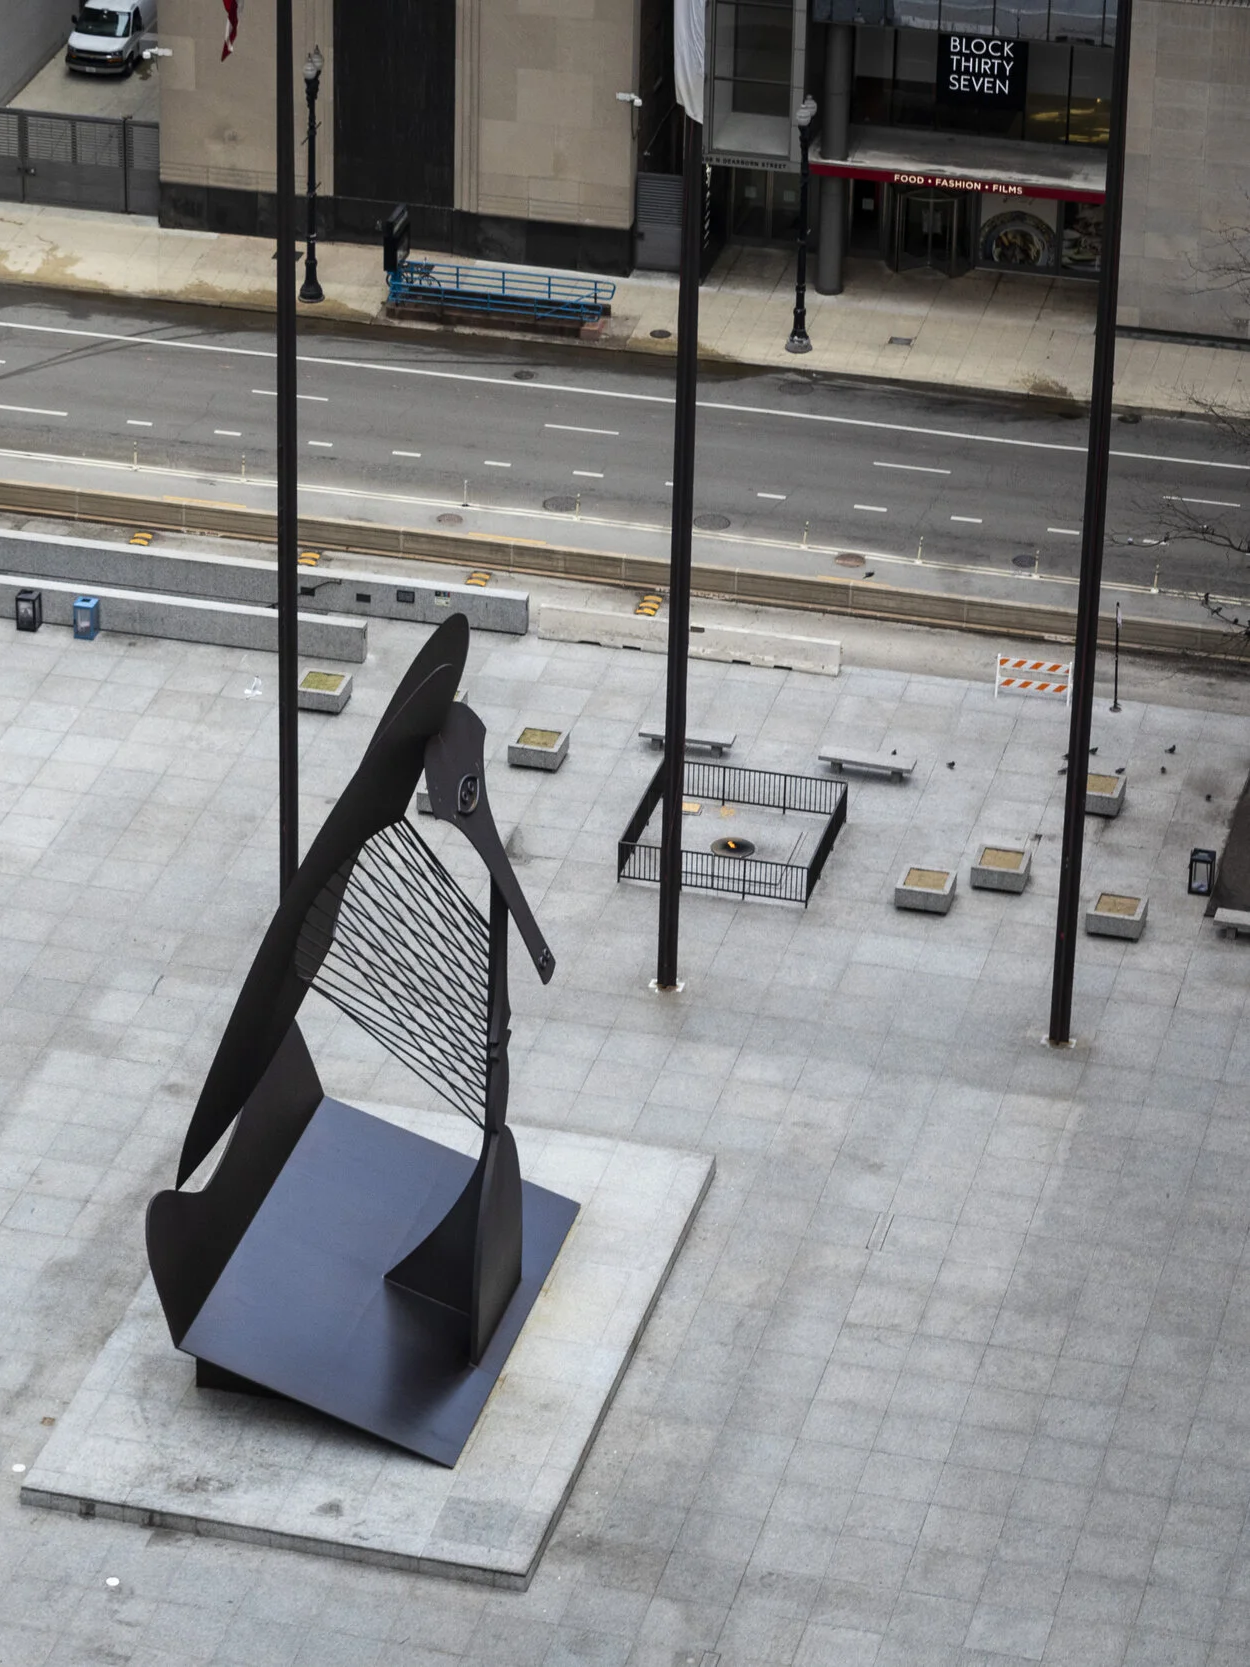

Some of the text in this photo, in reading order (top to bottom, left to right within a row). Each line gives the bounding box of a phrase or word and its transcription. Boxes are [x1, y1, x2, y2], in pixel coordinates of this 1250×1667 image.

[950, 36, 1015, 58] BLOCK
[950, 55, 1014, 77] THIRTY
[949, 74, 1009, 95] SEVEN
[893, 173, 1023, 195] FOOD FASHION FILMS
